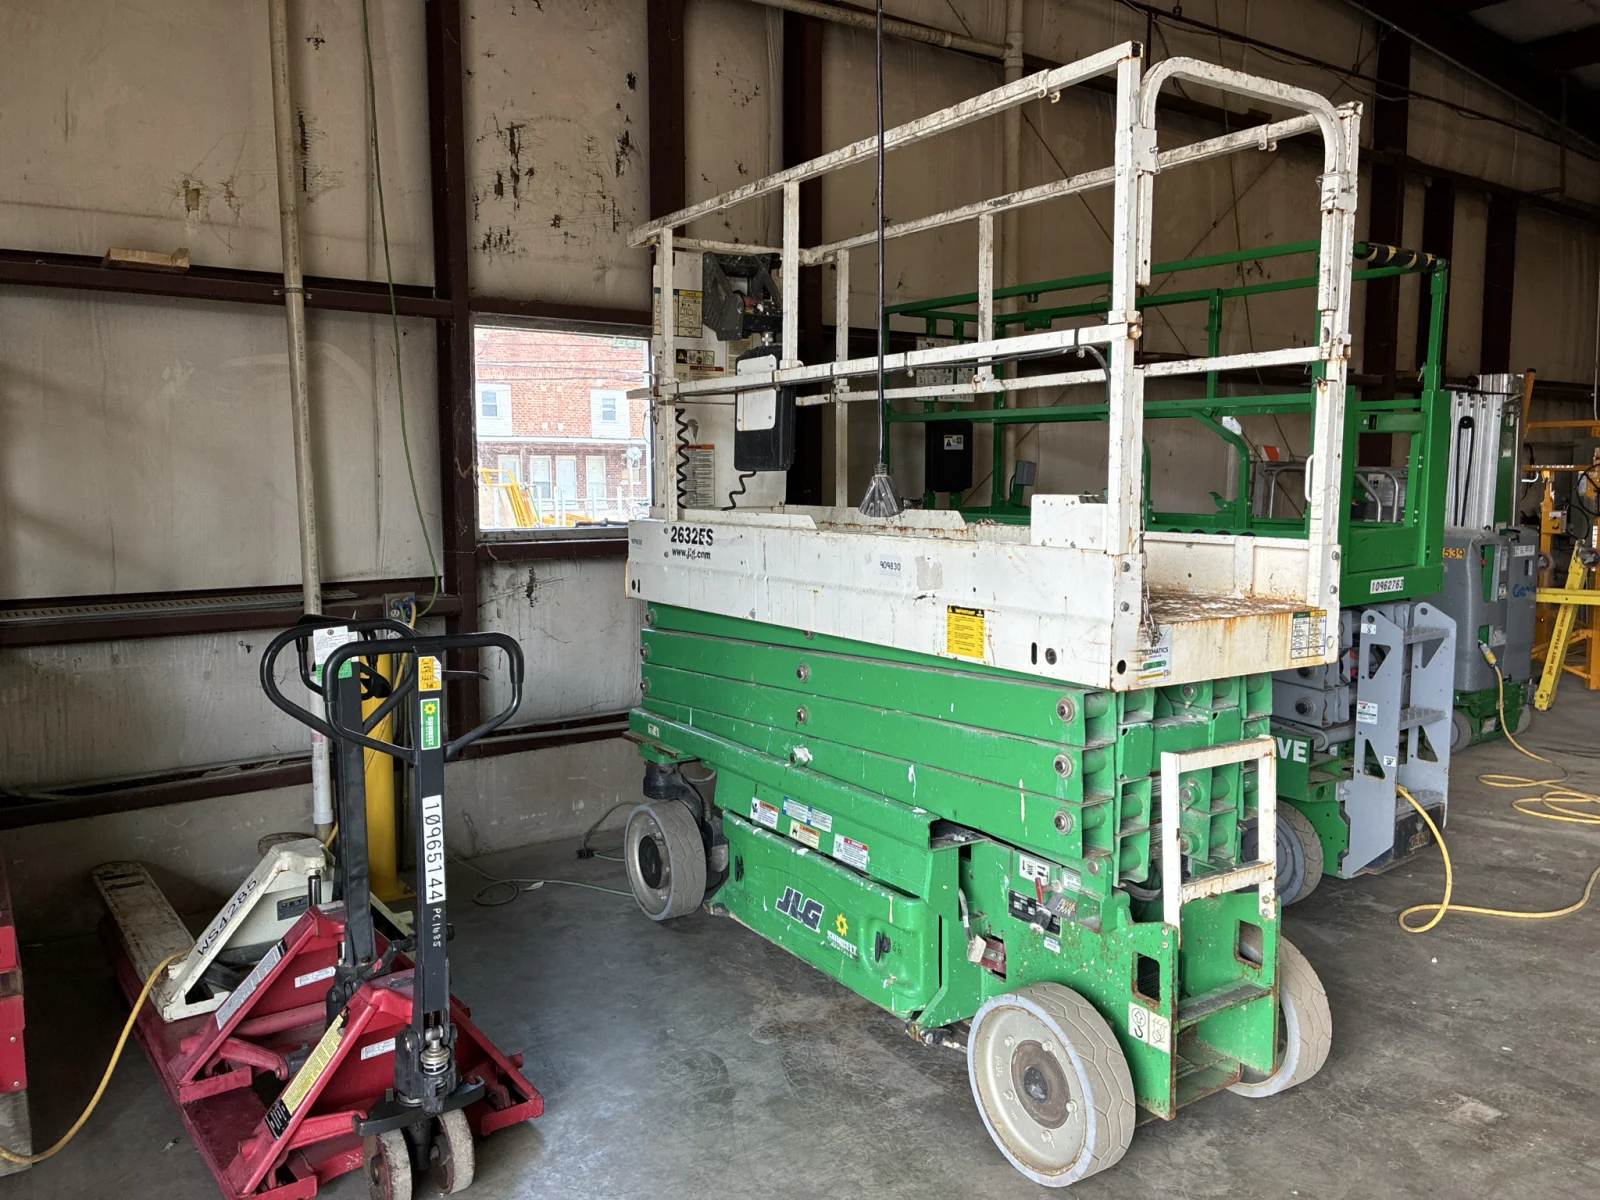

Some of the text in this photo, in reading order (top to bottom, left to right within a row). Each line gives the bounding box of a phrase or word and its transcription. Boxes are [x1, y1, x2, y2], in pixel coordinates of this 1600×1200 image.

[670, 525, 714, 546] 2632ES
[1443, 548, 1464, 558] 539
[1550, 652, 1558, 665] NOT
[427, 715, 435, 746] SUNBELT
[424, 802, 444, 901] 10965144
[197, 877, 257, 956] WS4285
[281, 898, 304, 909] JET
[774, 885, 825, 934] JLG
